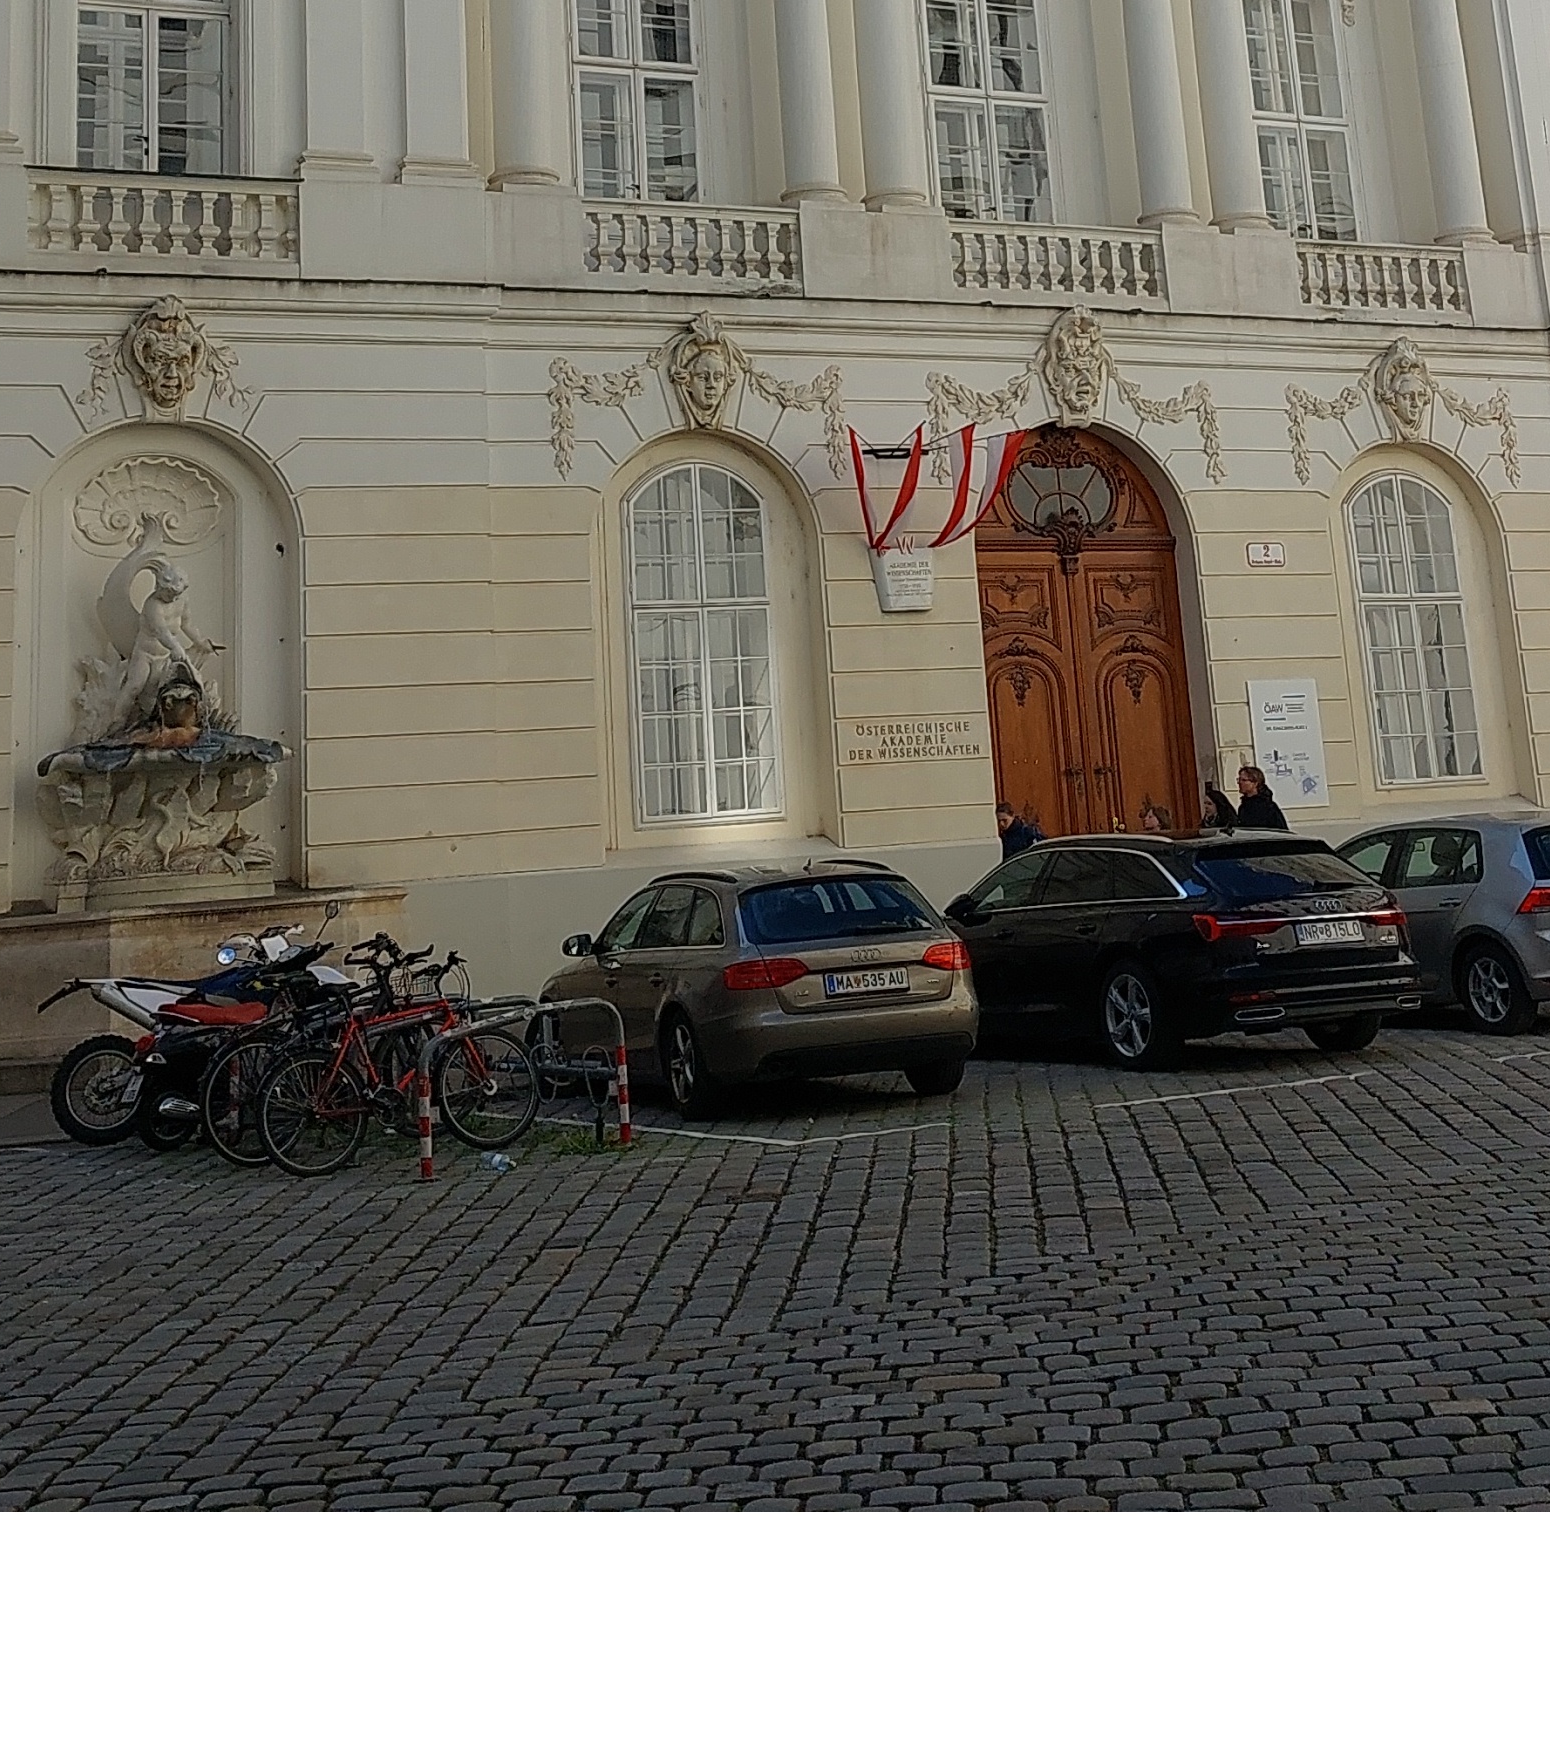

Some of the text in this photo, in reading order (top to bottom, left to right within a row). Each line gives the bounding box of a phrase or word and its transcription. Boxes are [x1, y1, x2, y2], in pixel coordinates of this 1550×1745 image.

[1262, 544, 1271, 558] 2
[1263, 701, 1284, 714] ÖAW
[855, 721, 970, 736] ÖSTERREICHISCHE
[880, 733, 947, 748] AKADEMIE
[848, 744, 981, 761] DER WISSENSCHAFTEN
[1304, 923, 1320, 941] NR
[835, 971, 905, 991] MA 535 AU
